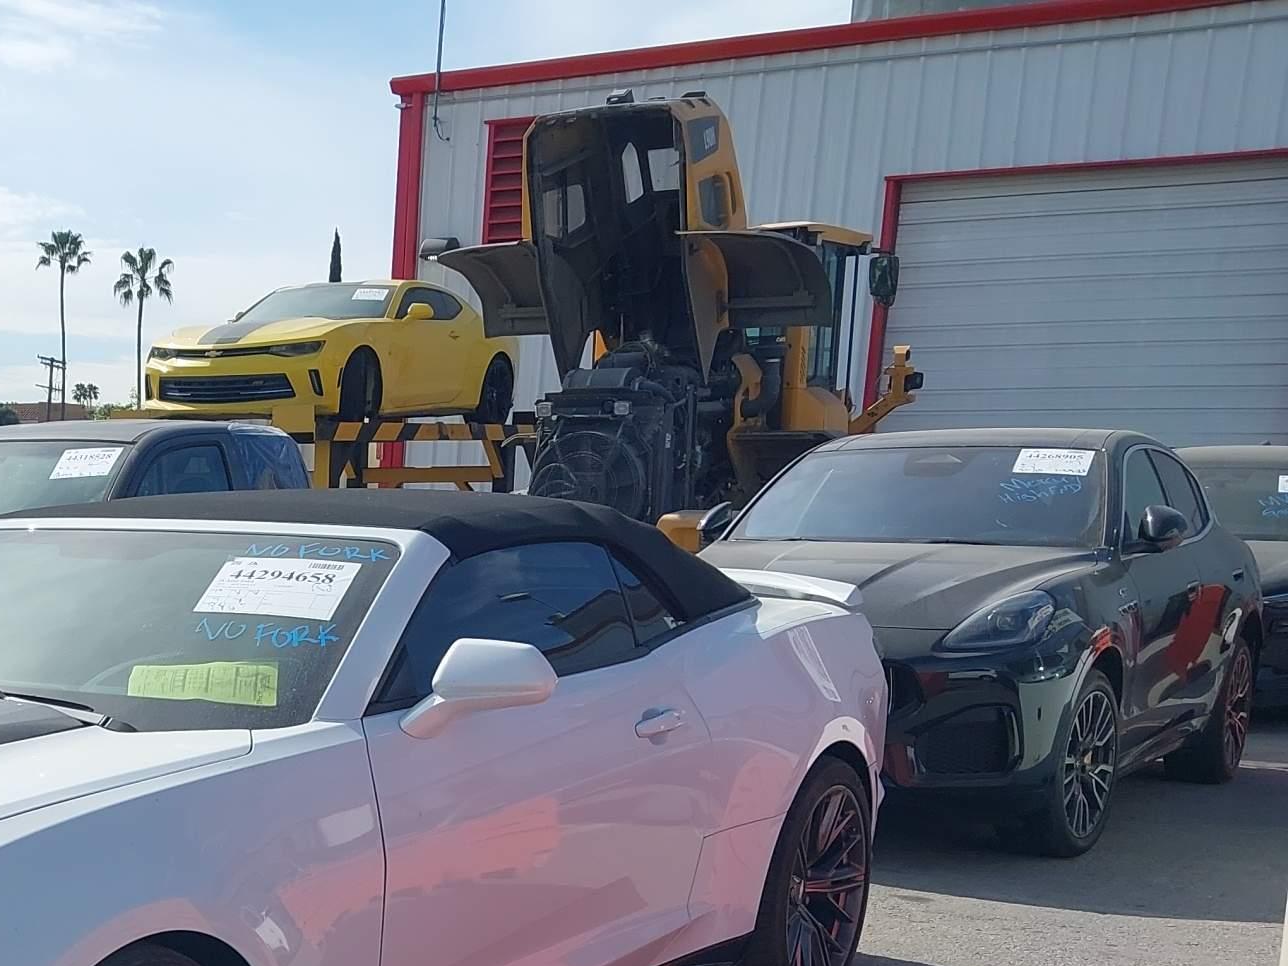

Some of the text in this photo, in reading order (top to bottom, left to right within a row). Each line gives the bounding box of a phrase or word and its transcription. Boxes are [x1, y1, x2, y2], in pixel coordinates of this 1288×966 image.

[298, 542, 391, 563] FORK
[229, 568, 337, 585] 44294658
[194, 617, 340, 648] NO FORK
